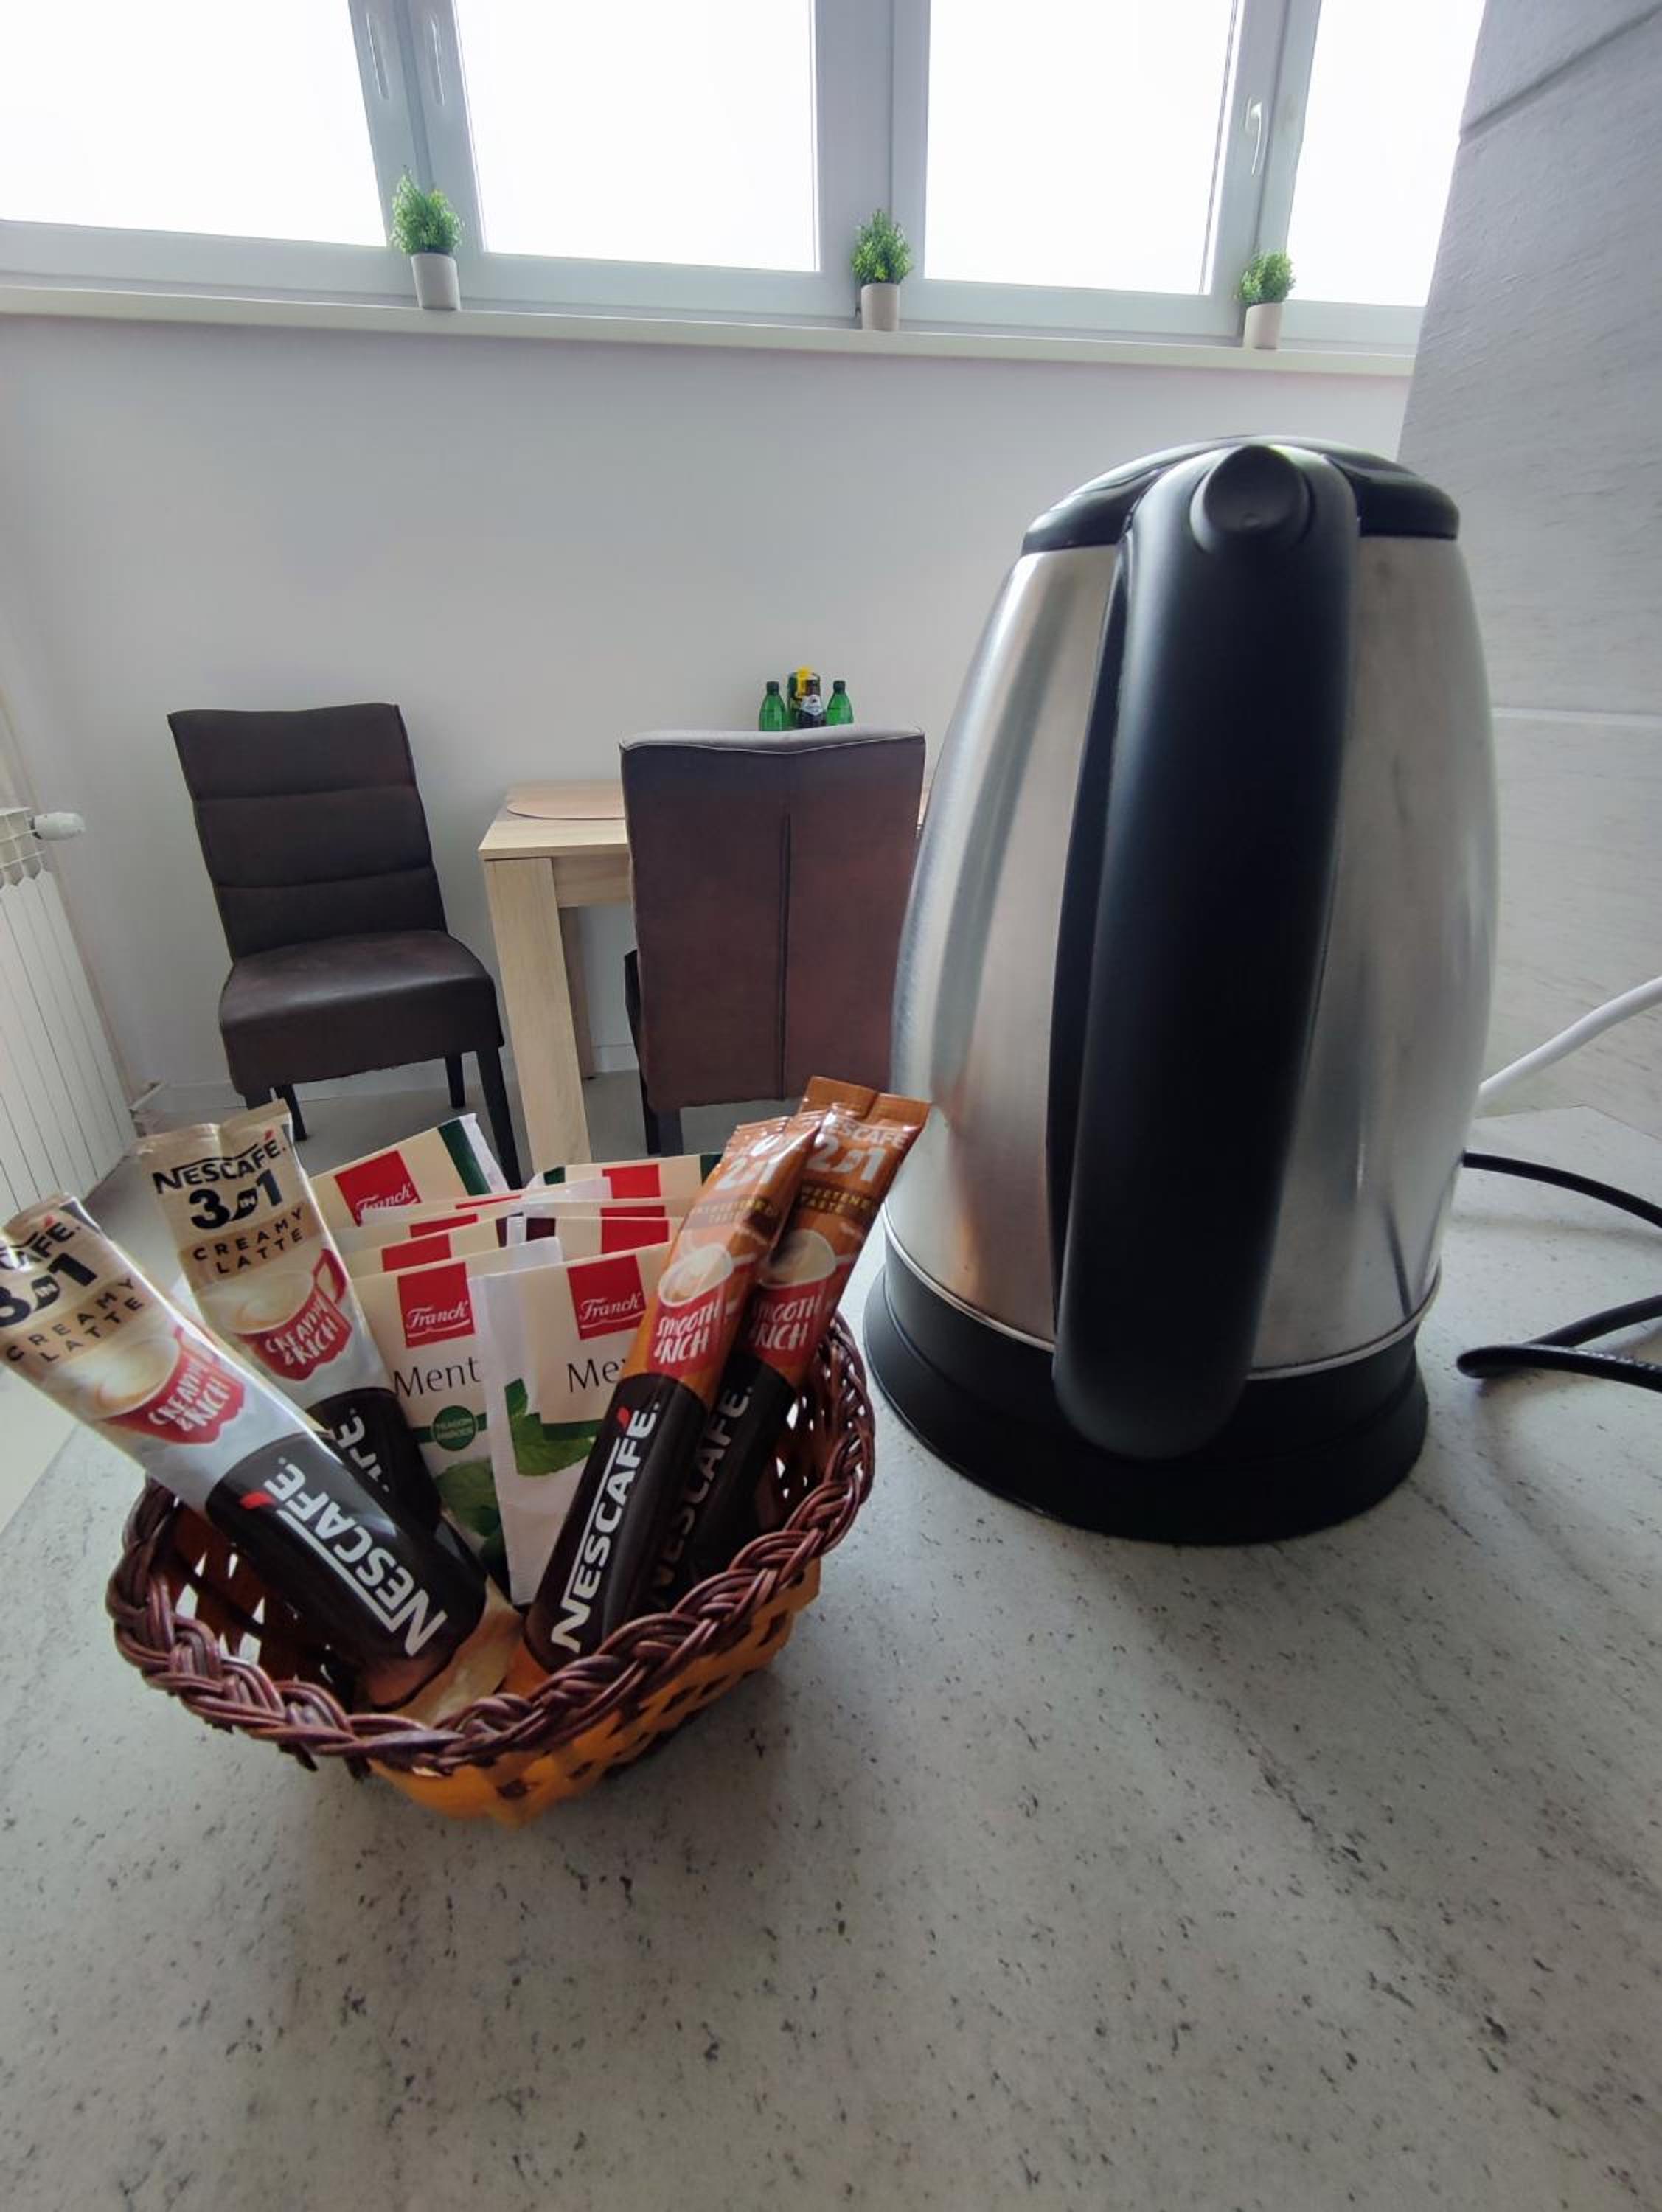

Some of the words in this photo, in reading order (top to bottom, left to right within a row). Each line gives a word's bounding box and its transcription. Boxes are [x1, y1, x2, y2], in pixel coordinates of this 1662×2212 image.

[193, 1207, 302, 1261] CREAMY
[216, 1228, 303, 1274] LATTE
[6, 1278, 134, 1362] CREAMY
[406, 1300, 469, 1329] Franck
[580, 1292, 641, 1321] Franck
[656, 1296, 721, 1337] SMOOTH
[40, 1297, 144, 1363] LATTE
[293, 1317, 339, 1366] RICH
[660, 1327, 709, 1364] RICH
[754, 1322, 809, 1351] RICH
[393, 1356, 481, 1398] Ment
[567, 1358, 627, 1393] Me
[184, 1375, 232, 1427] RICH
